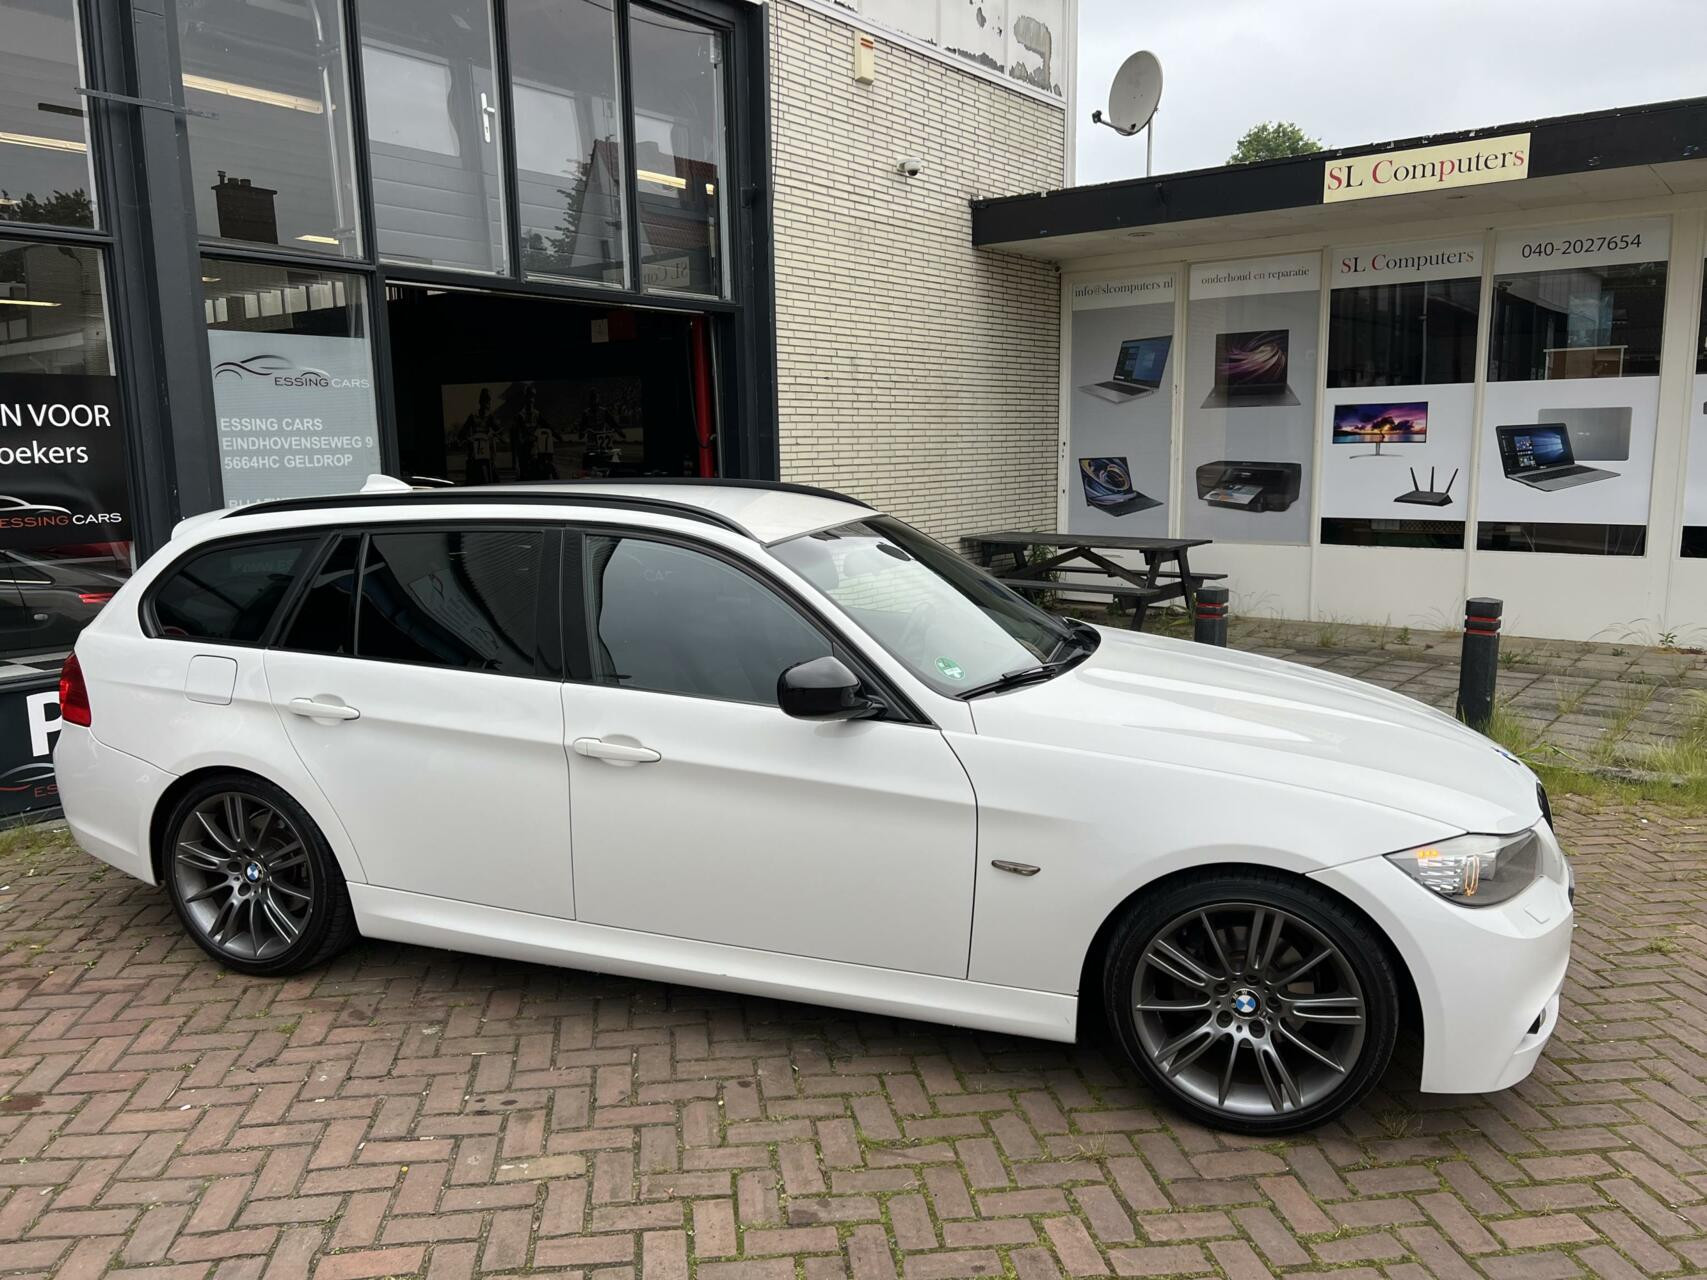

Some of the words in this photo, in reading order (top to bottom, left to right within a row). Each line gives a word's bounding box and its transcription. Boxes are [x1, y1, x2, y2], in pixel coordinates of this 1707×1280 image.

[1328, 165, 1363, 191] SL
[1372, 149, 1525, 184] Computers
[1521, 233, 1642, 259] 040-2027654
[1341, 257, 1366, 274] SL
[1371, 249, 1475, 271] Computers
[1201, 271, 1251, 284] onderhoud
[1253, 272, 1265, 280] en
[1268, 266, 1310, 281] reparatie
[274, 376, 329, 387] ESSING
[331, 378, 370, 388] CARS
[0, 403, 22, 427] N
[27, 403, 111, 427] VOOR
[220, 418, 278, 431] ESSING
[282, 418, 323, 431] CARS
[222, 436, 362, 450] EINDHOVENSEWEG
[365, 436, 373, 448] 9
[0, 440, 88, 465] oekers
[224, 457, 280, 469] 5664HC
[284, 454, 353, 468] GELDROP
[0, 515, 69, 528] ESSING
[72, 513, 122, 525] CARS
